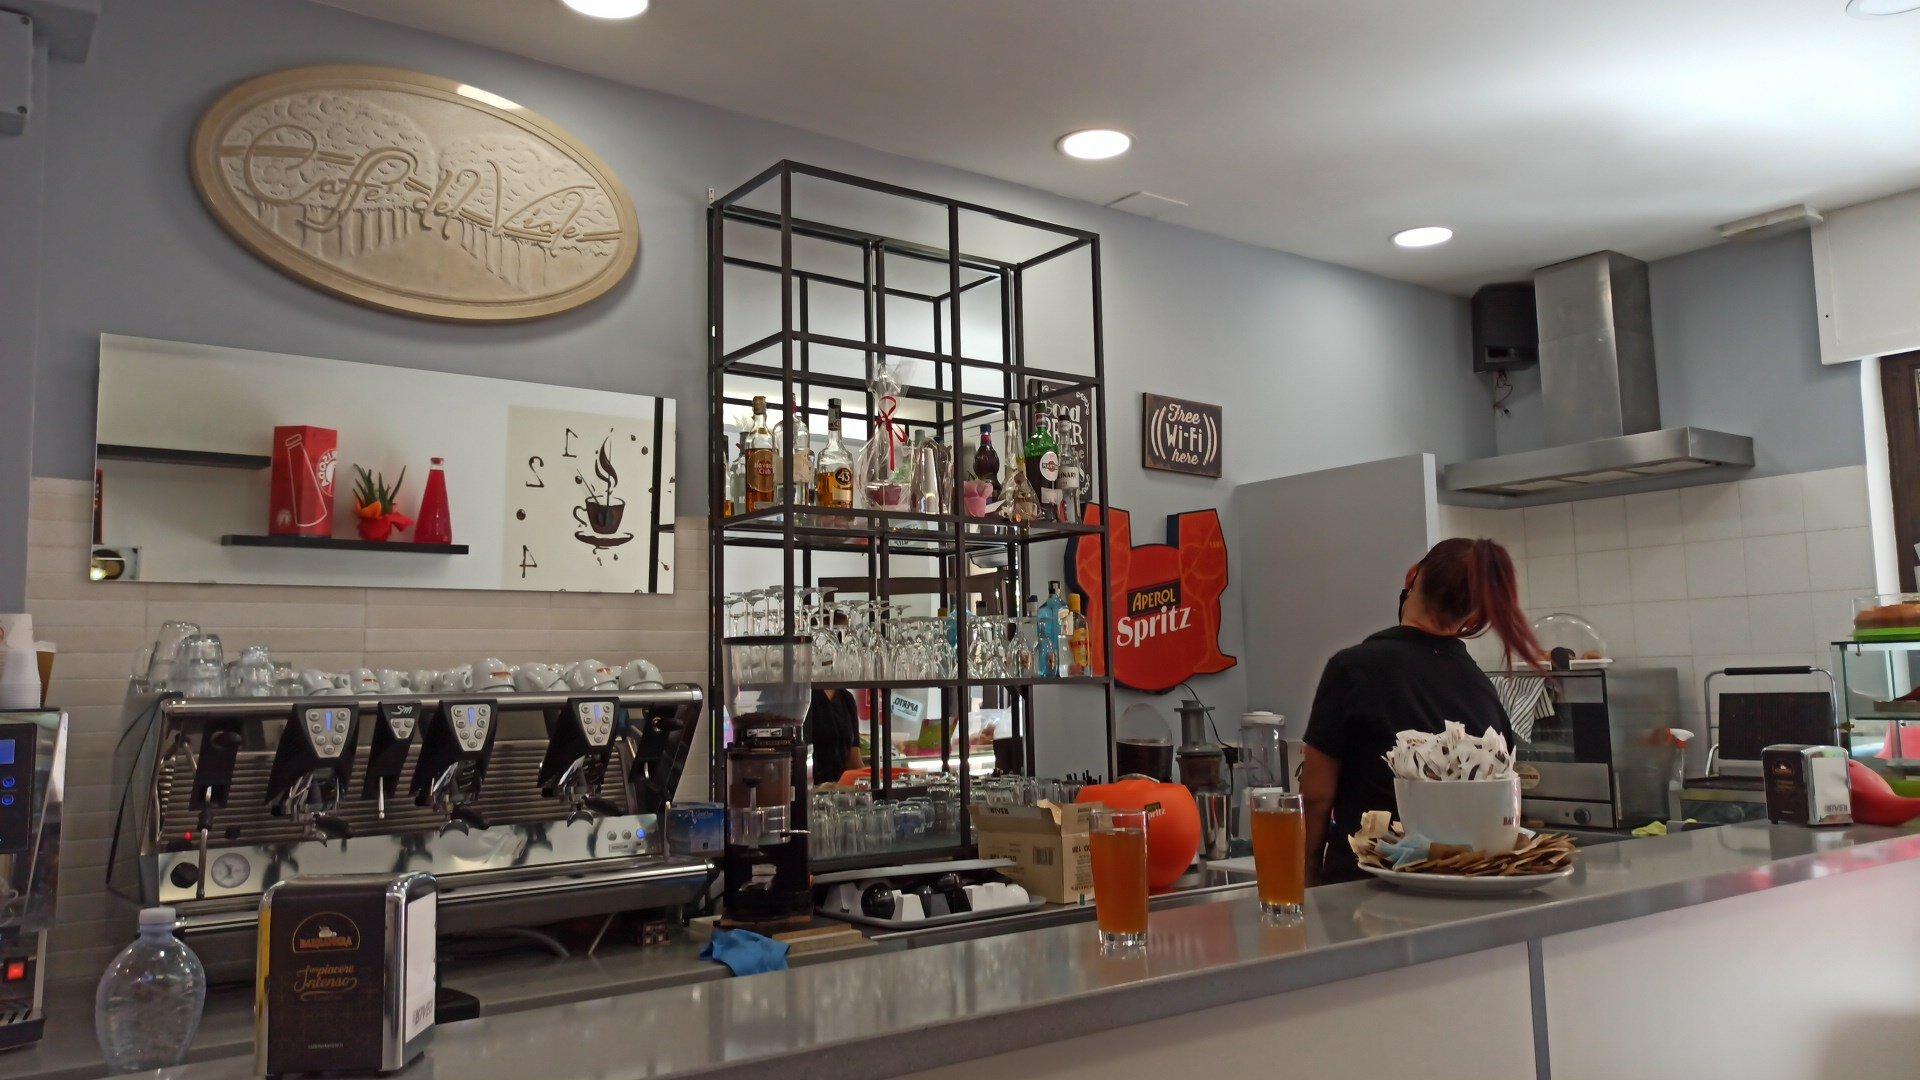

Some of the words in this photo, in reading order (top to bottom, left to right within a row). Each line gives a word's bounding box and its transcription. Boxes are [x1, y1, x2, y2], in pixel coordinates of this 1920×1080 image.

[487, 159, 596, 257] Viale
[1167, 403, 1201, 424] Free
[1171, 448, 1199, 465] here
[837, 469, 851, 482] 43
[1132, 588, 1176, 612] APEROL
[1116, 605, 1192, 648] Spritz
